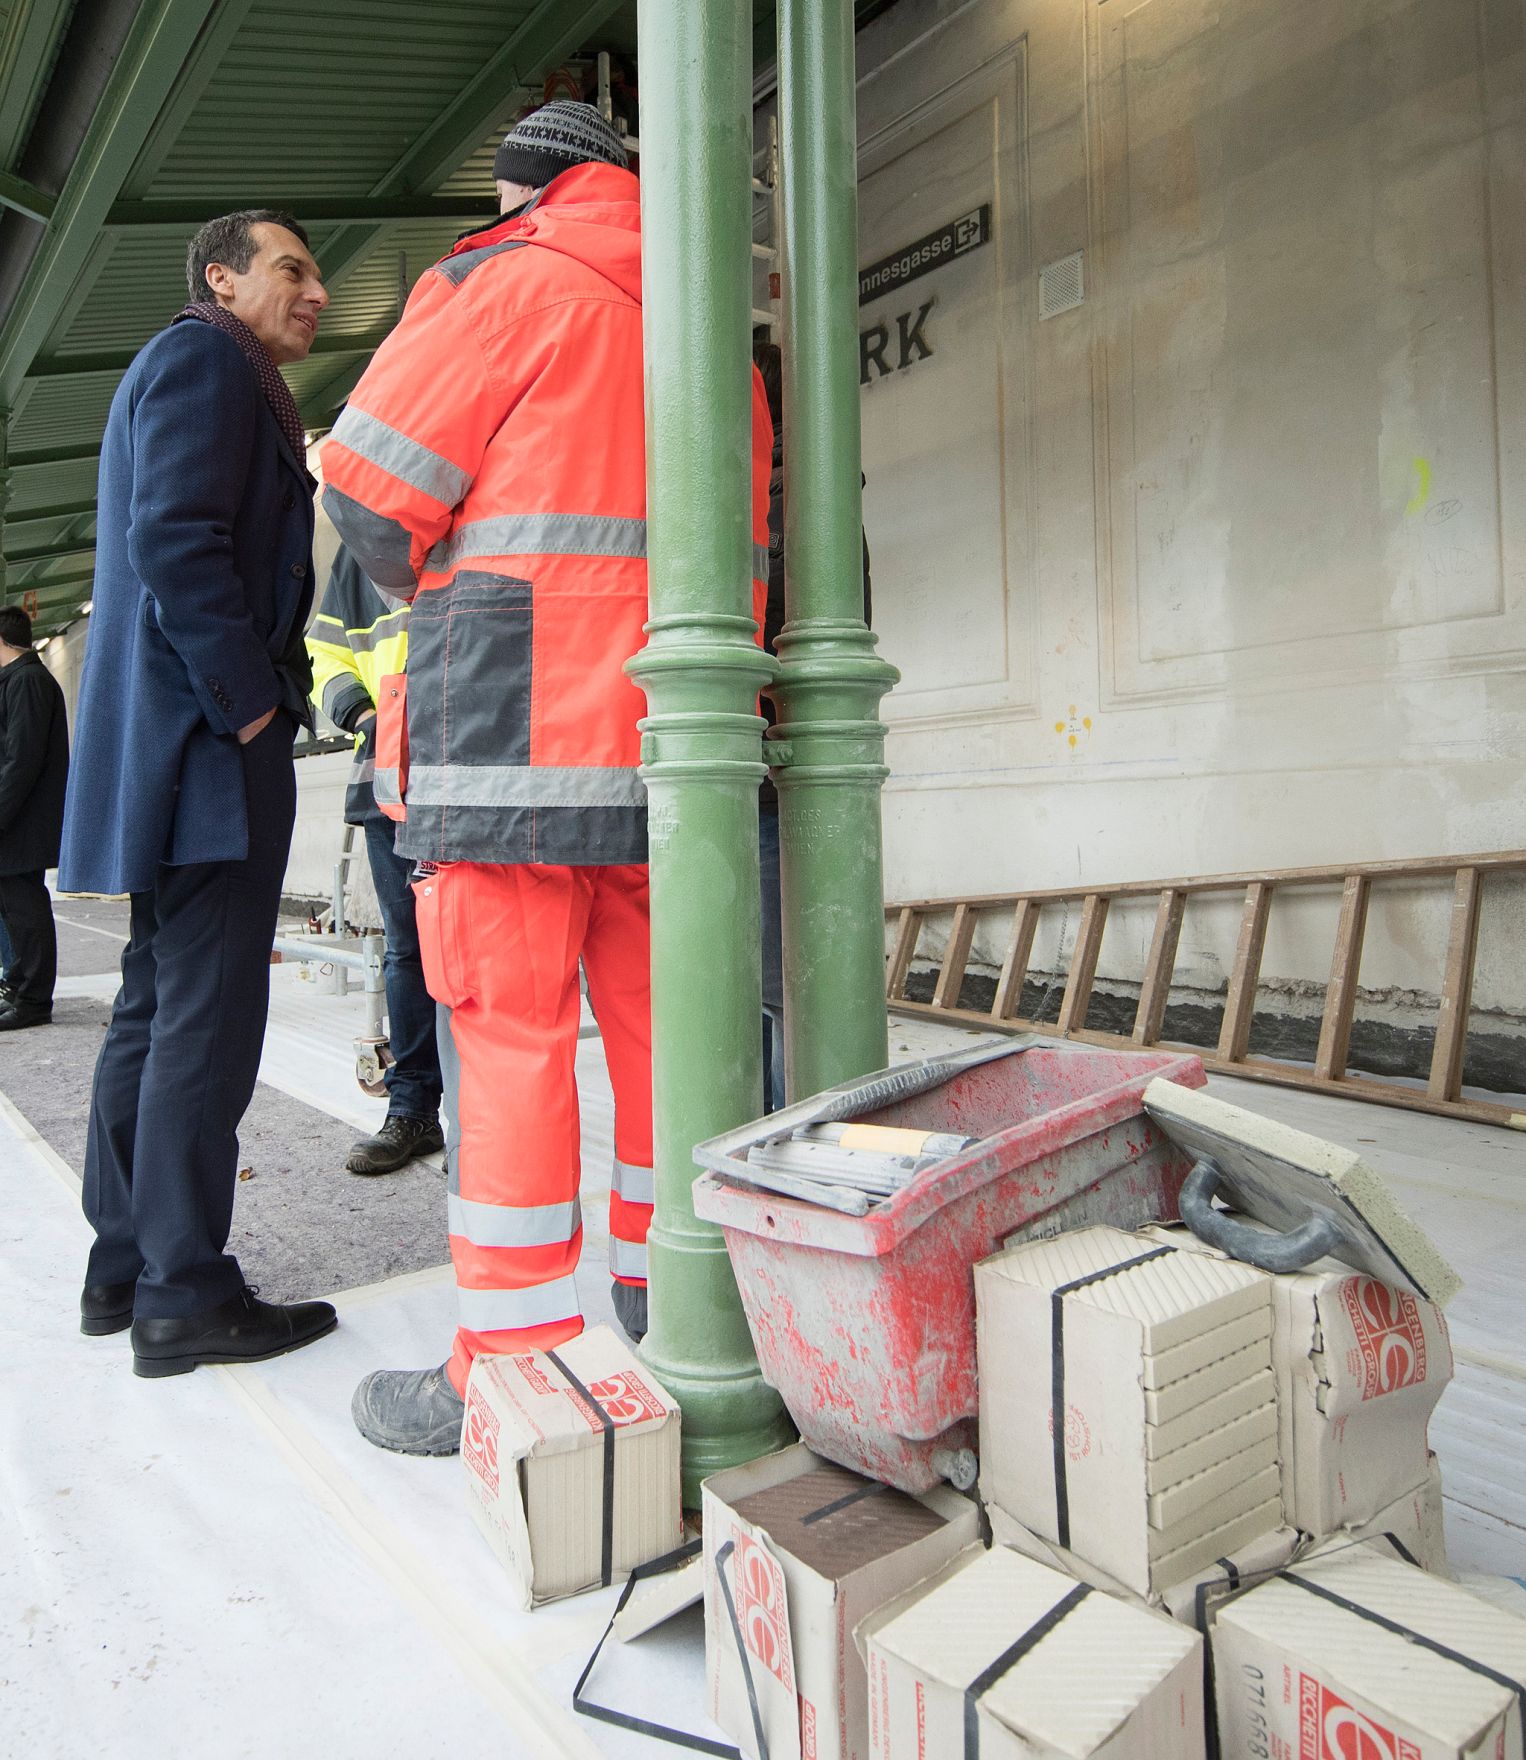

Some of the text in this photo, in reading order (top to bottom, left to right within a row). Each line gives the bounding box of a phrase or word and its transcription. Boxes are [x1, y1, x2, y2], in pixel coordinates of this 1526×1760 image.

[859, 233, 953, 294] nnesgasse
[1402, 1289, 1425, 1381] NGENBERG
[1363, 1349, 1376, 1398] GROUP
